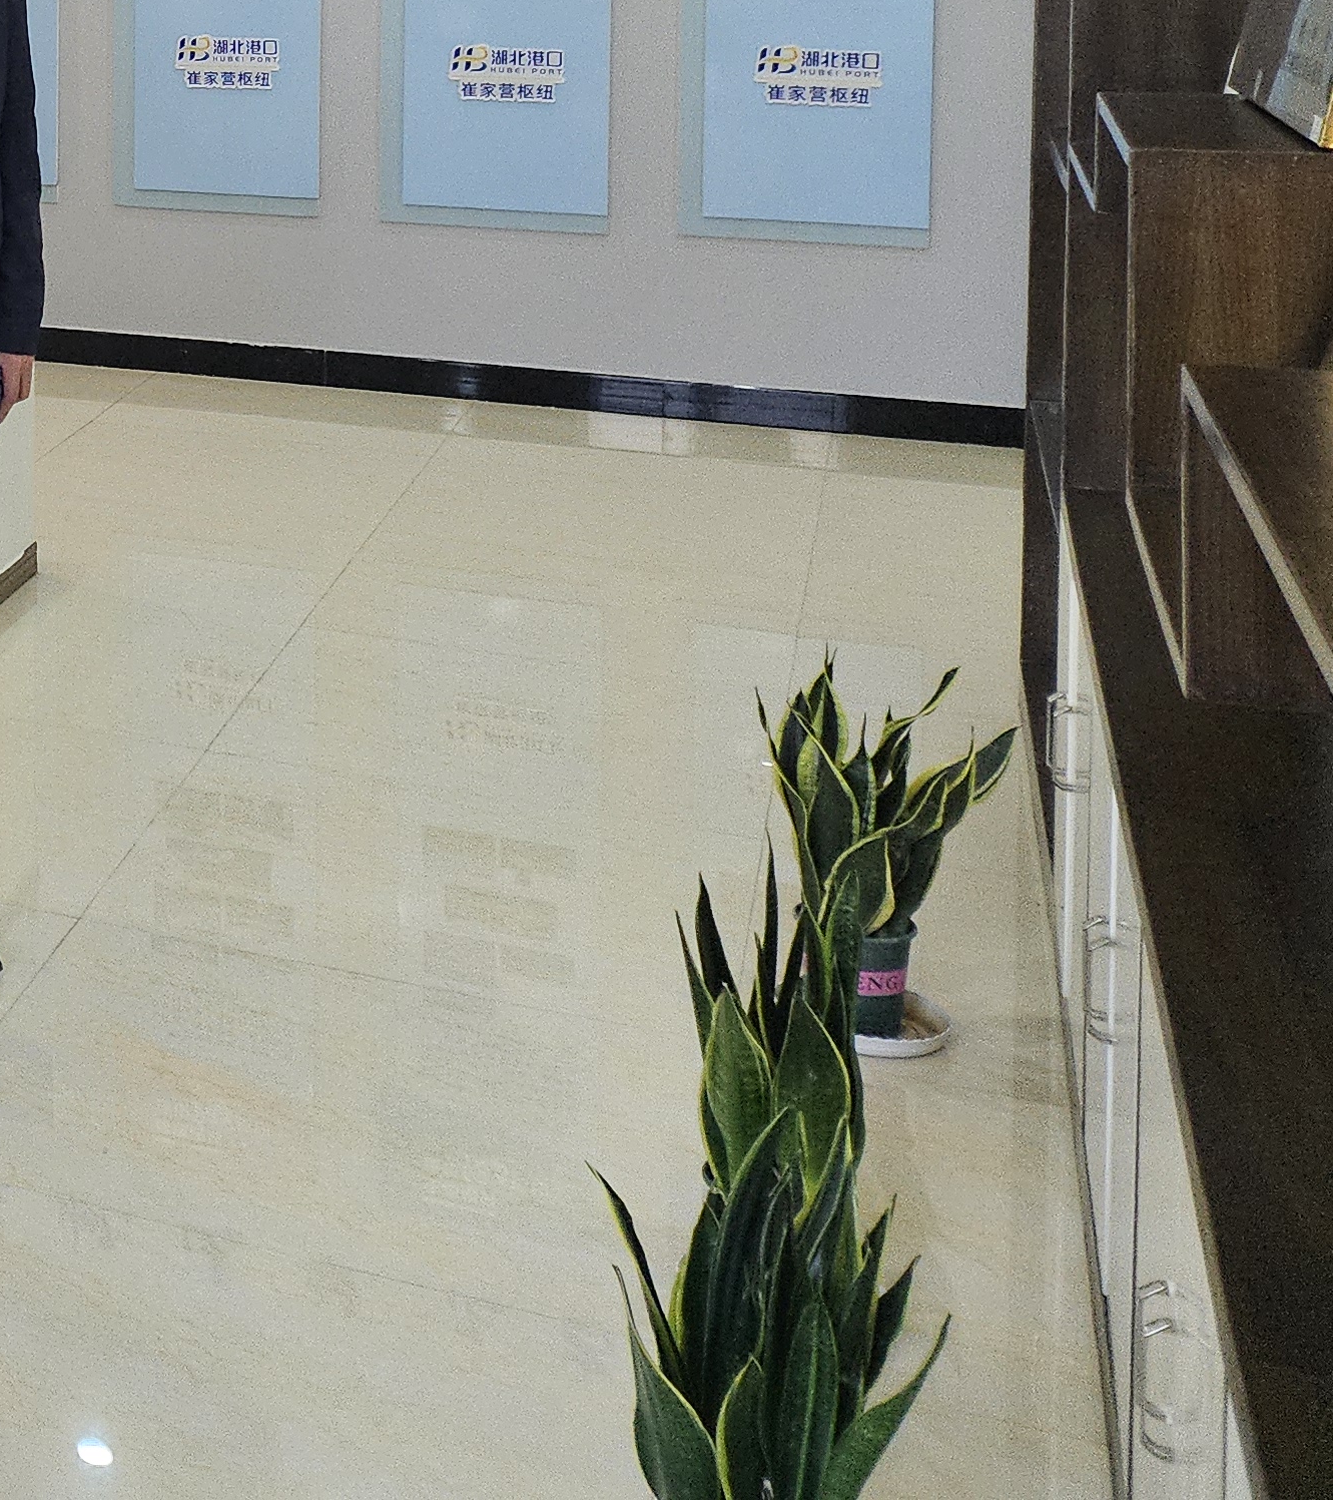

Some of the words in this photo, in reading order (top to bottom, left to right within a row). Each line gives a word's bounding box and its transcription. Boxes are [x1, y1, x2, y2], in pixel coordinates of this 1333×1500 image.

[213, 40, 278, 55] 湖北港口
[491, 50, 563, 67] 湖北港口
[801, 51, 880, 69] 湖北港口
[187, 71, 271, 86] 崔家营枢纽
[462, 83, 554, 100] 崔家营枢纽
[768, 85, 869, 104] 崔家营枢纽
